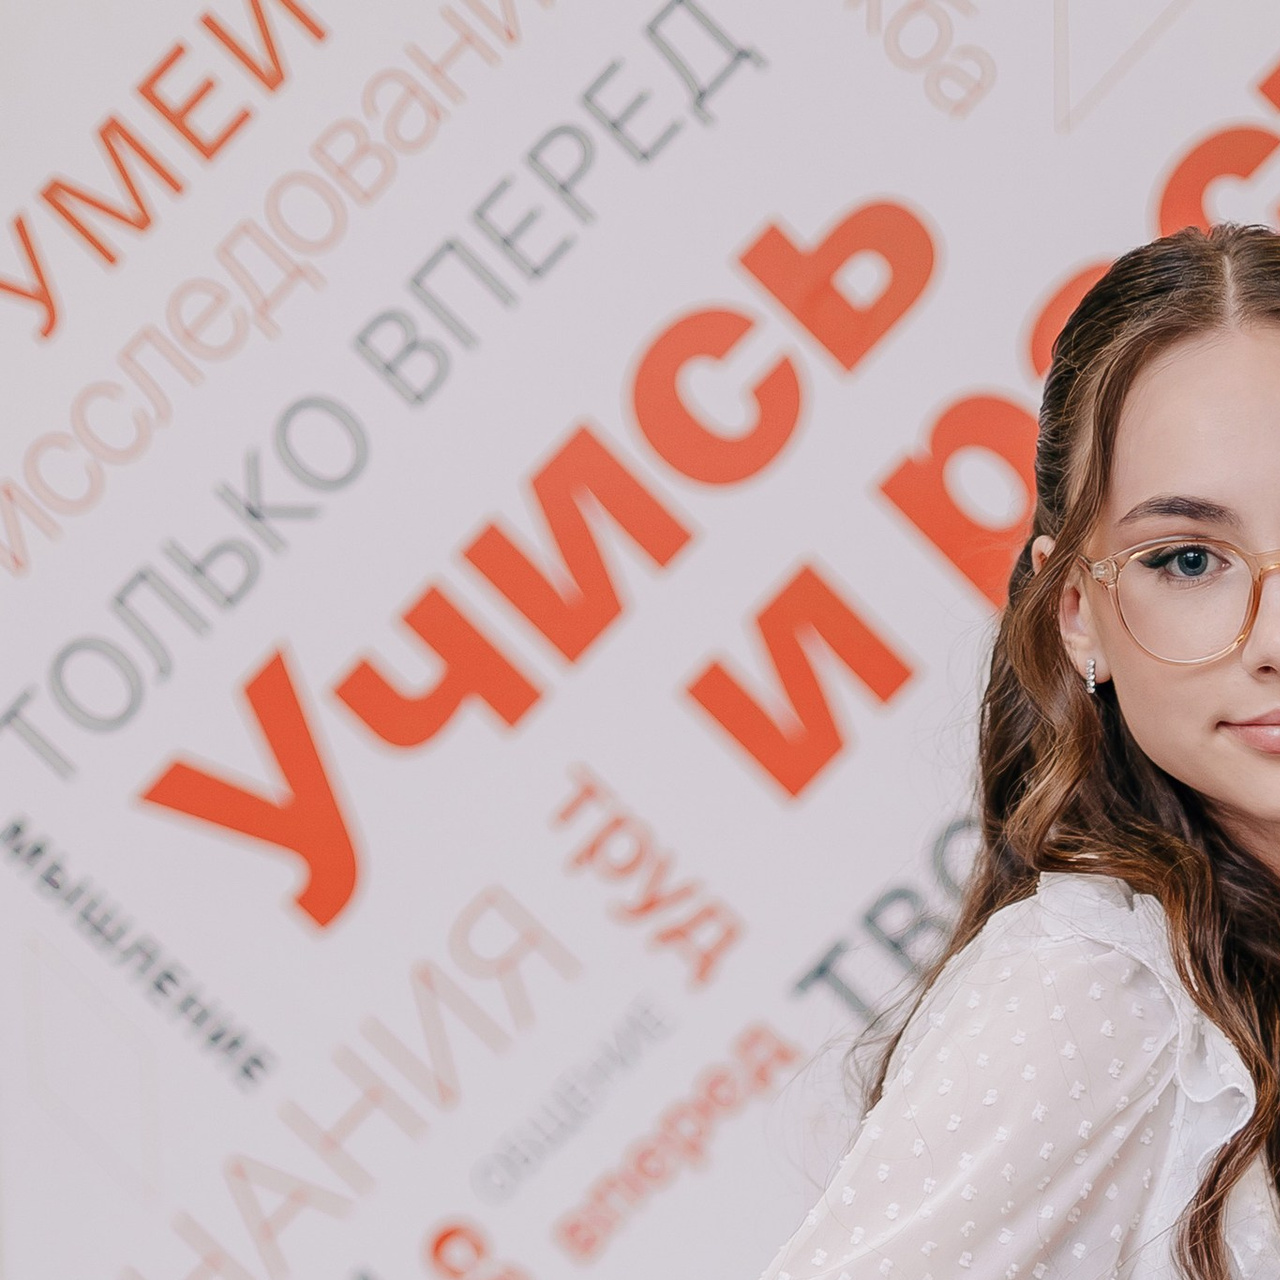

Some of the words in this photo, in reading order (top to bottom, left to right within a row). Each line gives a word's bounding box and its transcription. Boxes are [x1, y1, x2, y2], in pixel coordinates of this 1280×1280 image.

[0, 394, 370, 781] ТОЛЬКО
[352, 0, 770, 407] ВПЕРЕД
[138, 198, 940, 932] Учись
[684, 562, 917, 801] и
[2, 815, 273, 1088] МЫШЛЕНИЕ
[552, 763, 745, 990] труд
[556, 1022, 800, 1266] вперед
